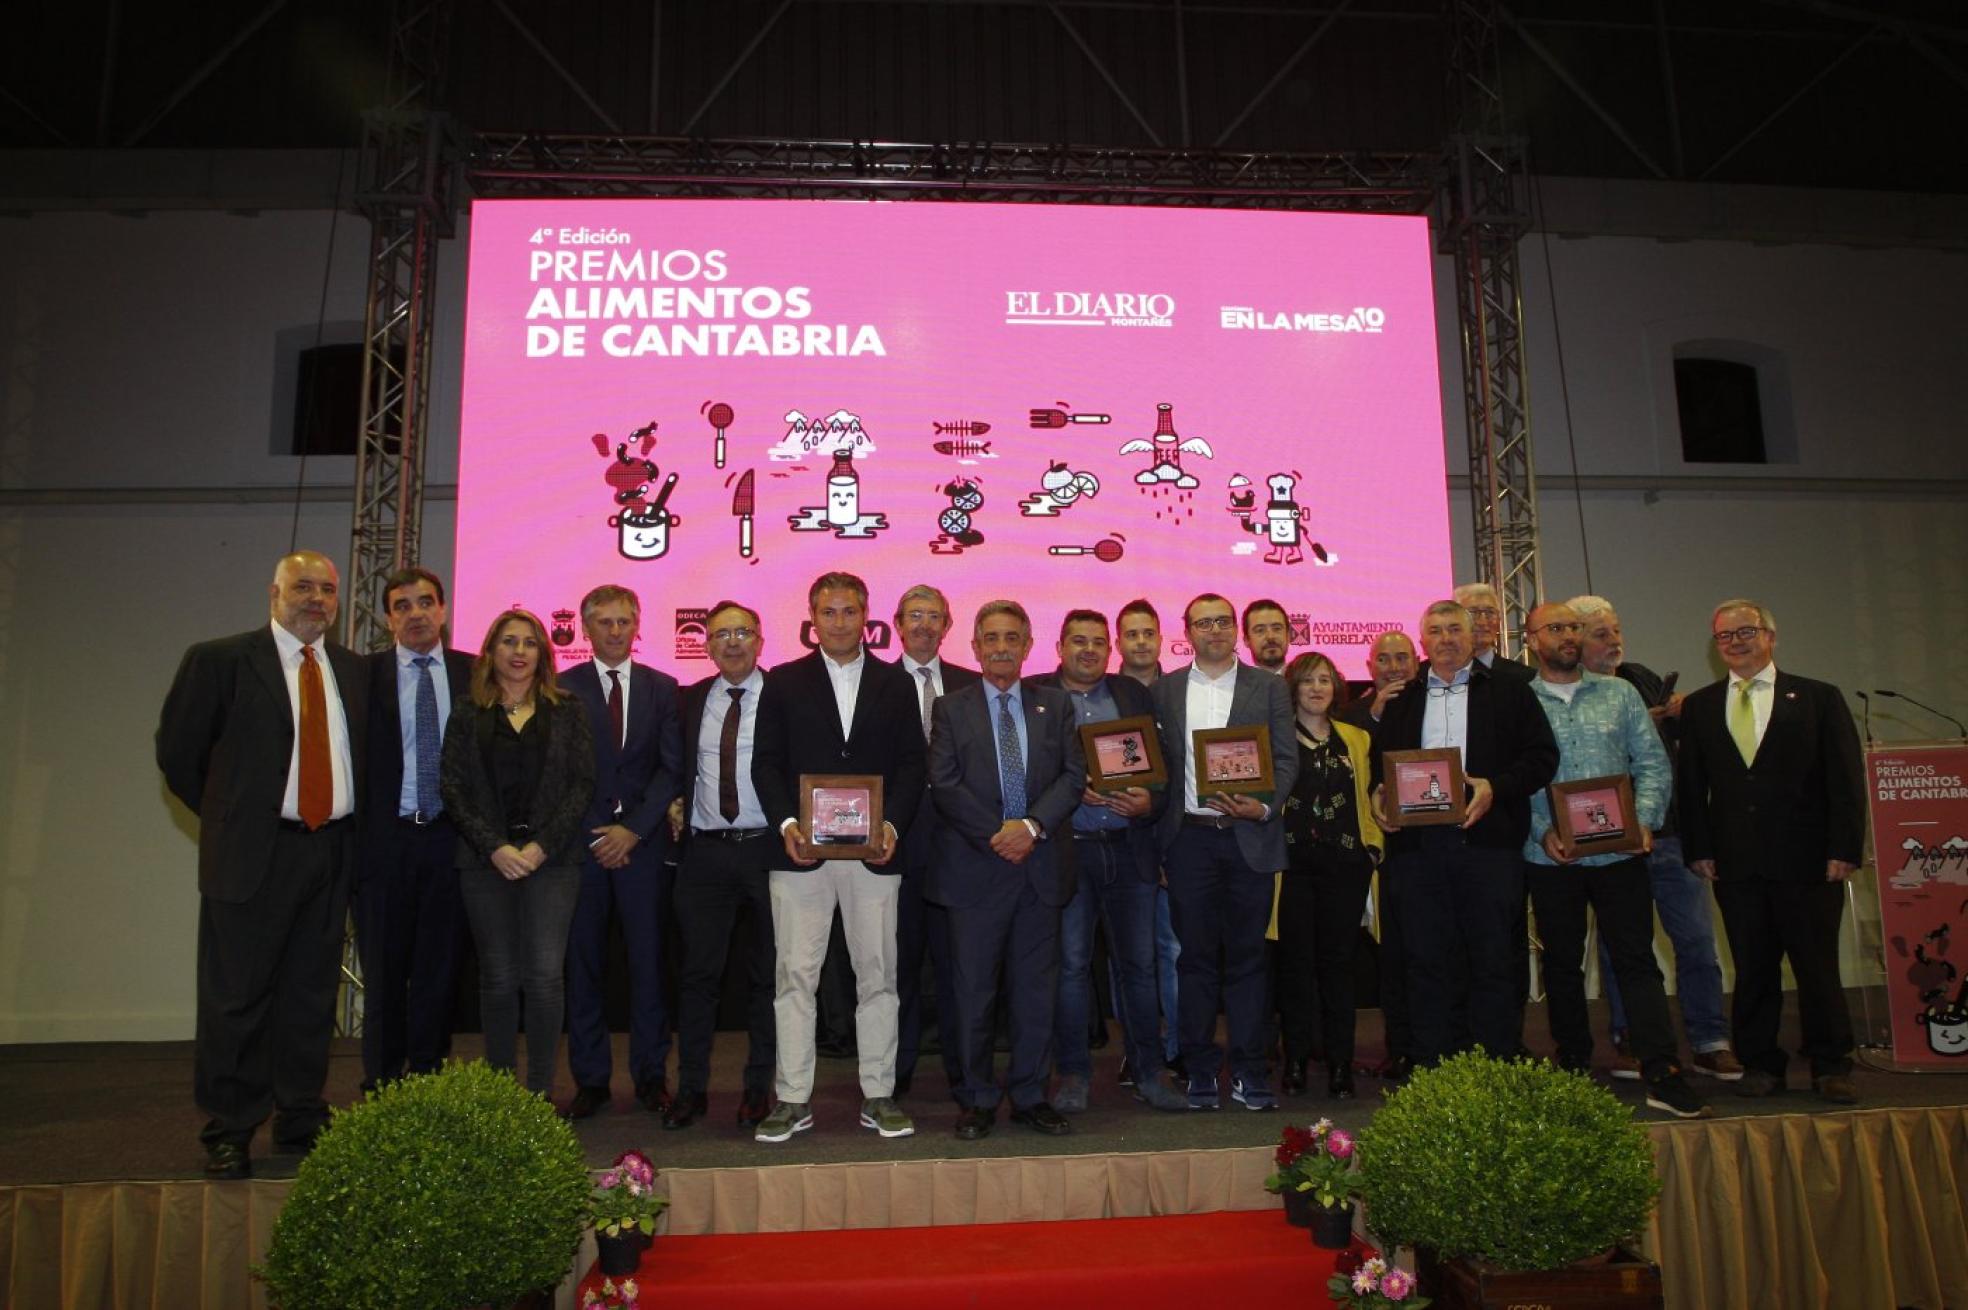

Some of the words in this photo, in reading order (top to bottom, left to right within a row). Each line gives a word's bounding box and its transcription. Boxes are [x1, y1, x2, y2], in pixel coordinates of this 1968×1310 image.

[528, 228, 552, 244] 4ª
[558, 227, 630, 244] Edición
[529, 249, 728, 282] PREMIOS
[525, 286, 812, 319] ALIMENTOS
[1006, 291, 1050, 315] EL
[1054, 292, 1174, 317] DIARIO
[1221, 311, 1254, 329] EN
[1257, 312, 1292, 330] LA
[1294, 313, 1363, 332] MESA
[526, 325, 585, 357] DE
[601, 325, 887, 356] CANTABRIA
[1312, 622, 1404, 633] AYUNTAMIENTO
[1313, 634, 1375, 645] TORRELAV
[1876, 765, 1936, 777] PREMIOS
[1877, 776, 1961, 789] ALIMENTOS
[1878, 790, 1897, 801] DE
[1901, 787, 1968, 800] CANTABR
